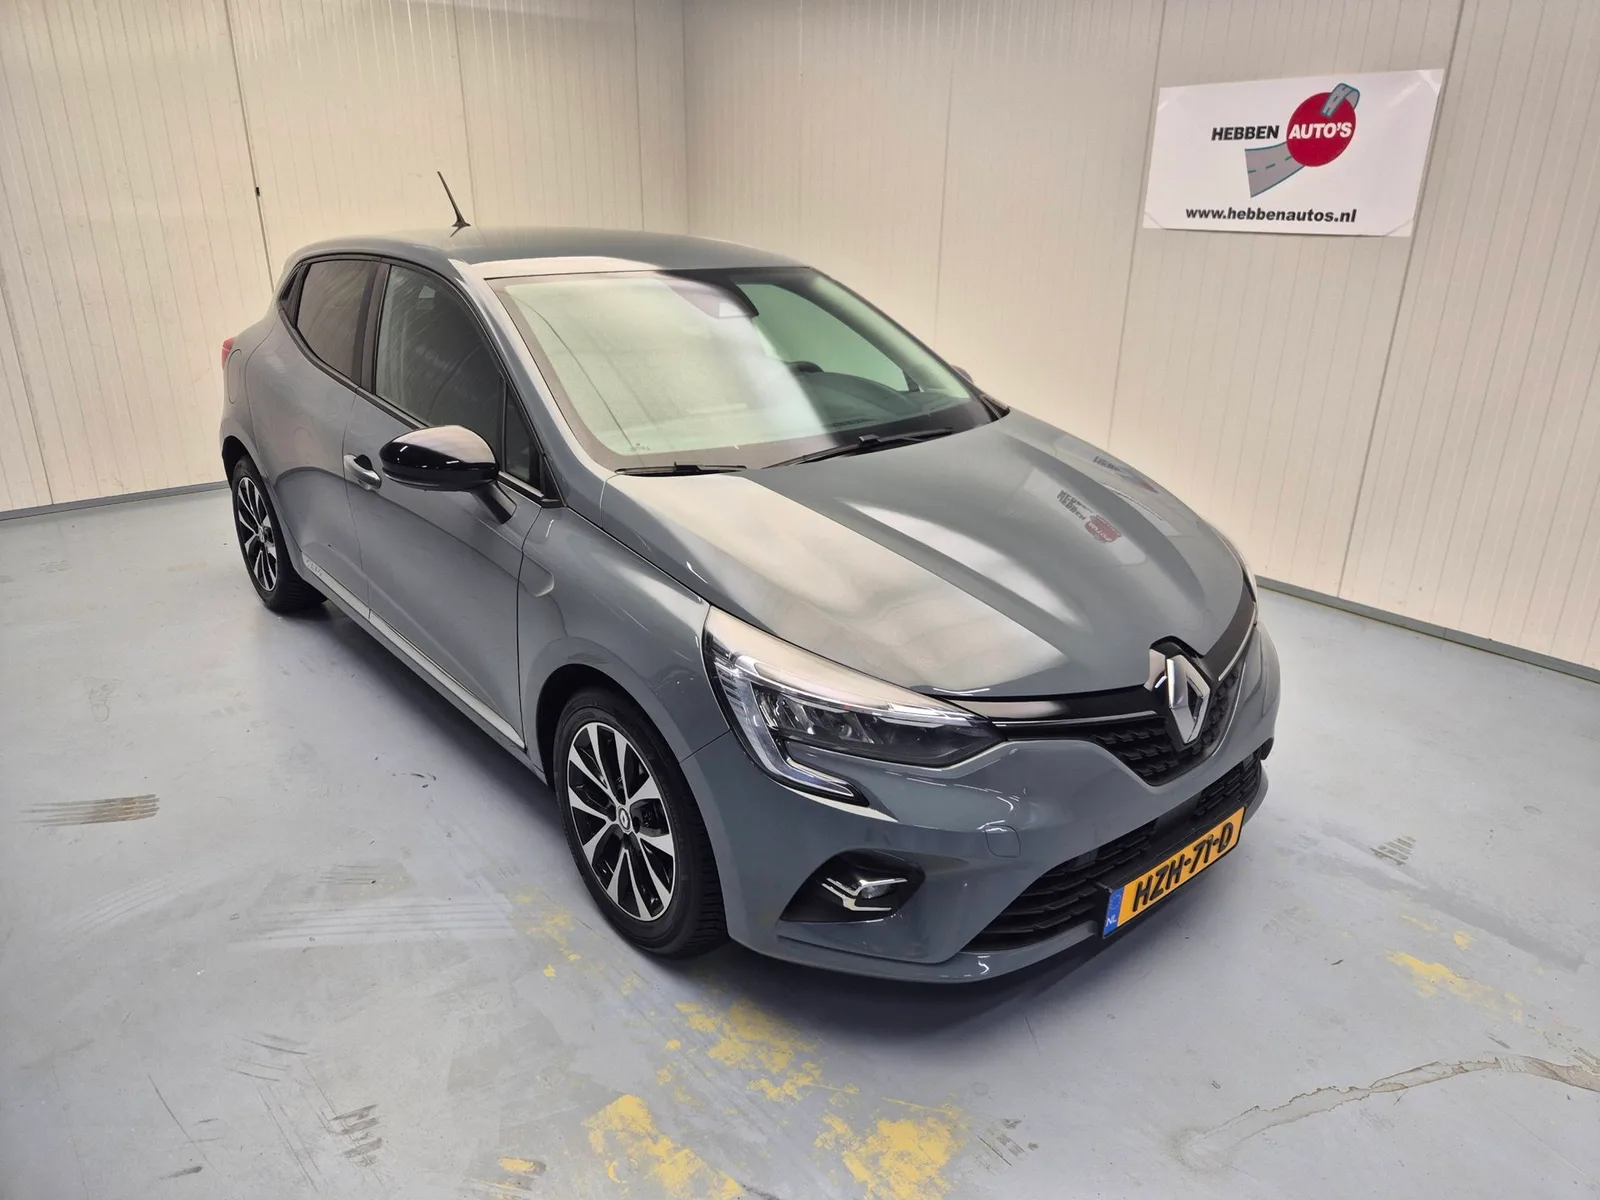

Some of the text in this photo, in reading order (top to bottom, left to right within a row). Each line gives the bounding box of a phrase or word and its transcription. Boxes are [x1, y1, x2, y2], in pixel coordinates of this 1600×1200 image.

[1211, 121, 1353, 141] HEBBEN AUTO'S
[1185, 207, 1357, 223] www.hebbenautos.nl
[1106, 821, 1234, 927] NL HZH-71-D
